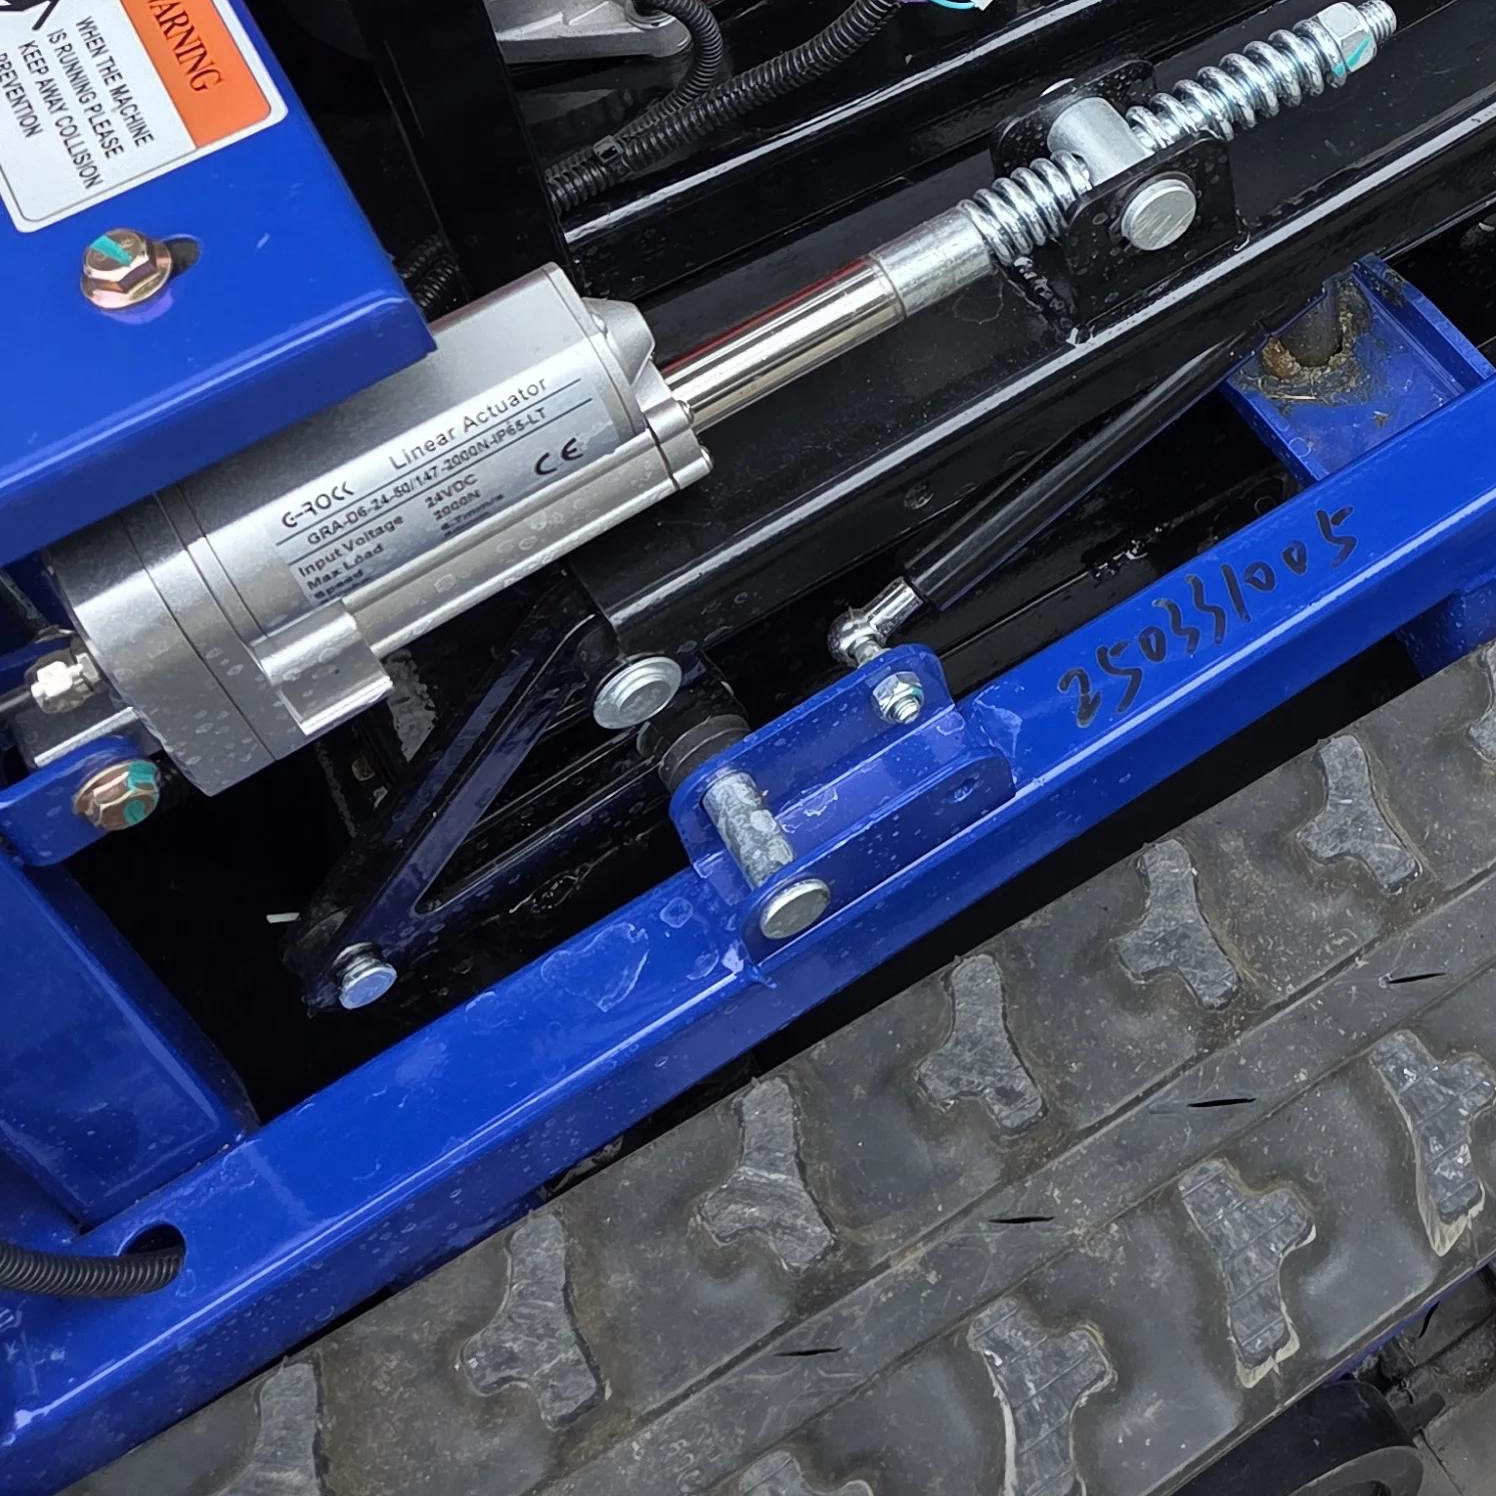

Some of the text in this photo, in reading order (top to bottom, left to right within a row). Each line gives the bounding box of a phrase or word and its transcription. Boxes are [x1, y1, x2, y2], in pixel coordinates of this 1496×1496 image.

[18, 40, 104, 189] KEEP AWAY COLLISION
[47, 28, 125, 159] IS RUNNING PLEASE
[75, 16, 155, 147] WHEN THE MACHINE
[388, 426, 456, 470] Linear
[462, 377, 547, 433] Actuator
[534, 437, 585, 476] CE
[298, 549, 343, 578] Input
[342, 515, 404, 551] Voltage
[424, 473, 478, 509] 24VDC
[307, 569, 341, 591] Max
[343, 544, 385, 571] Load
